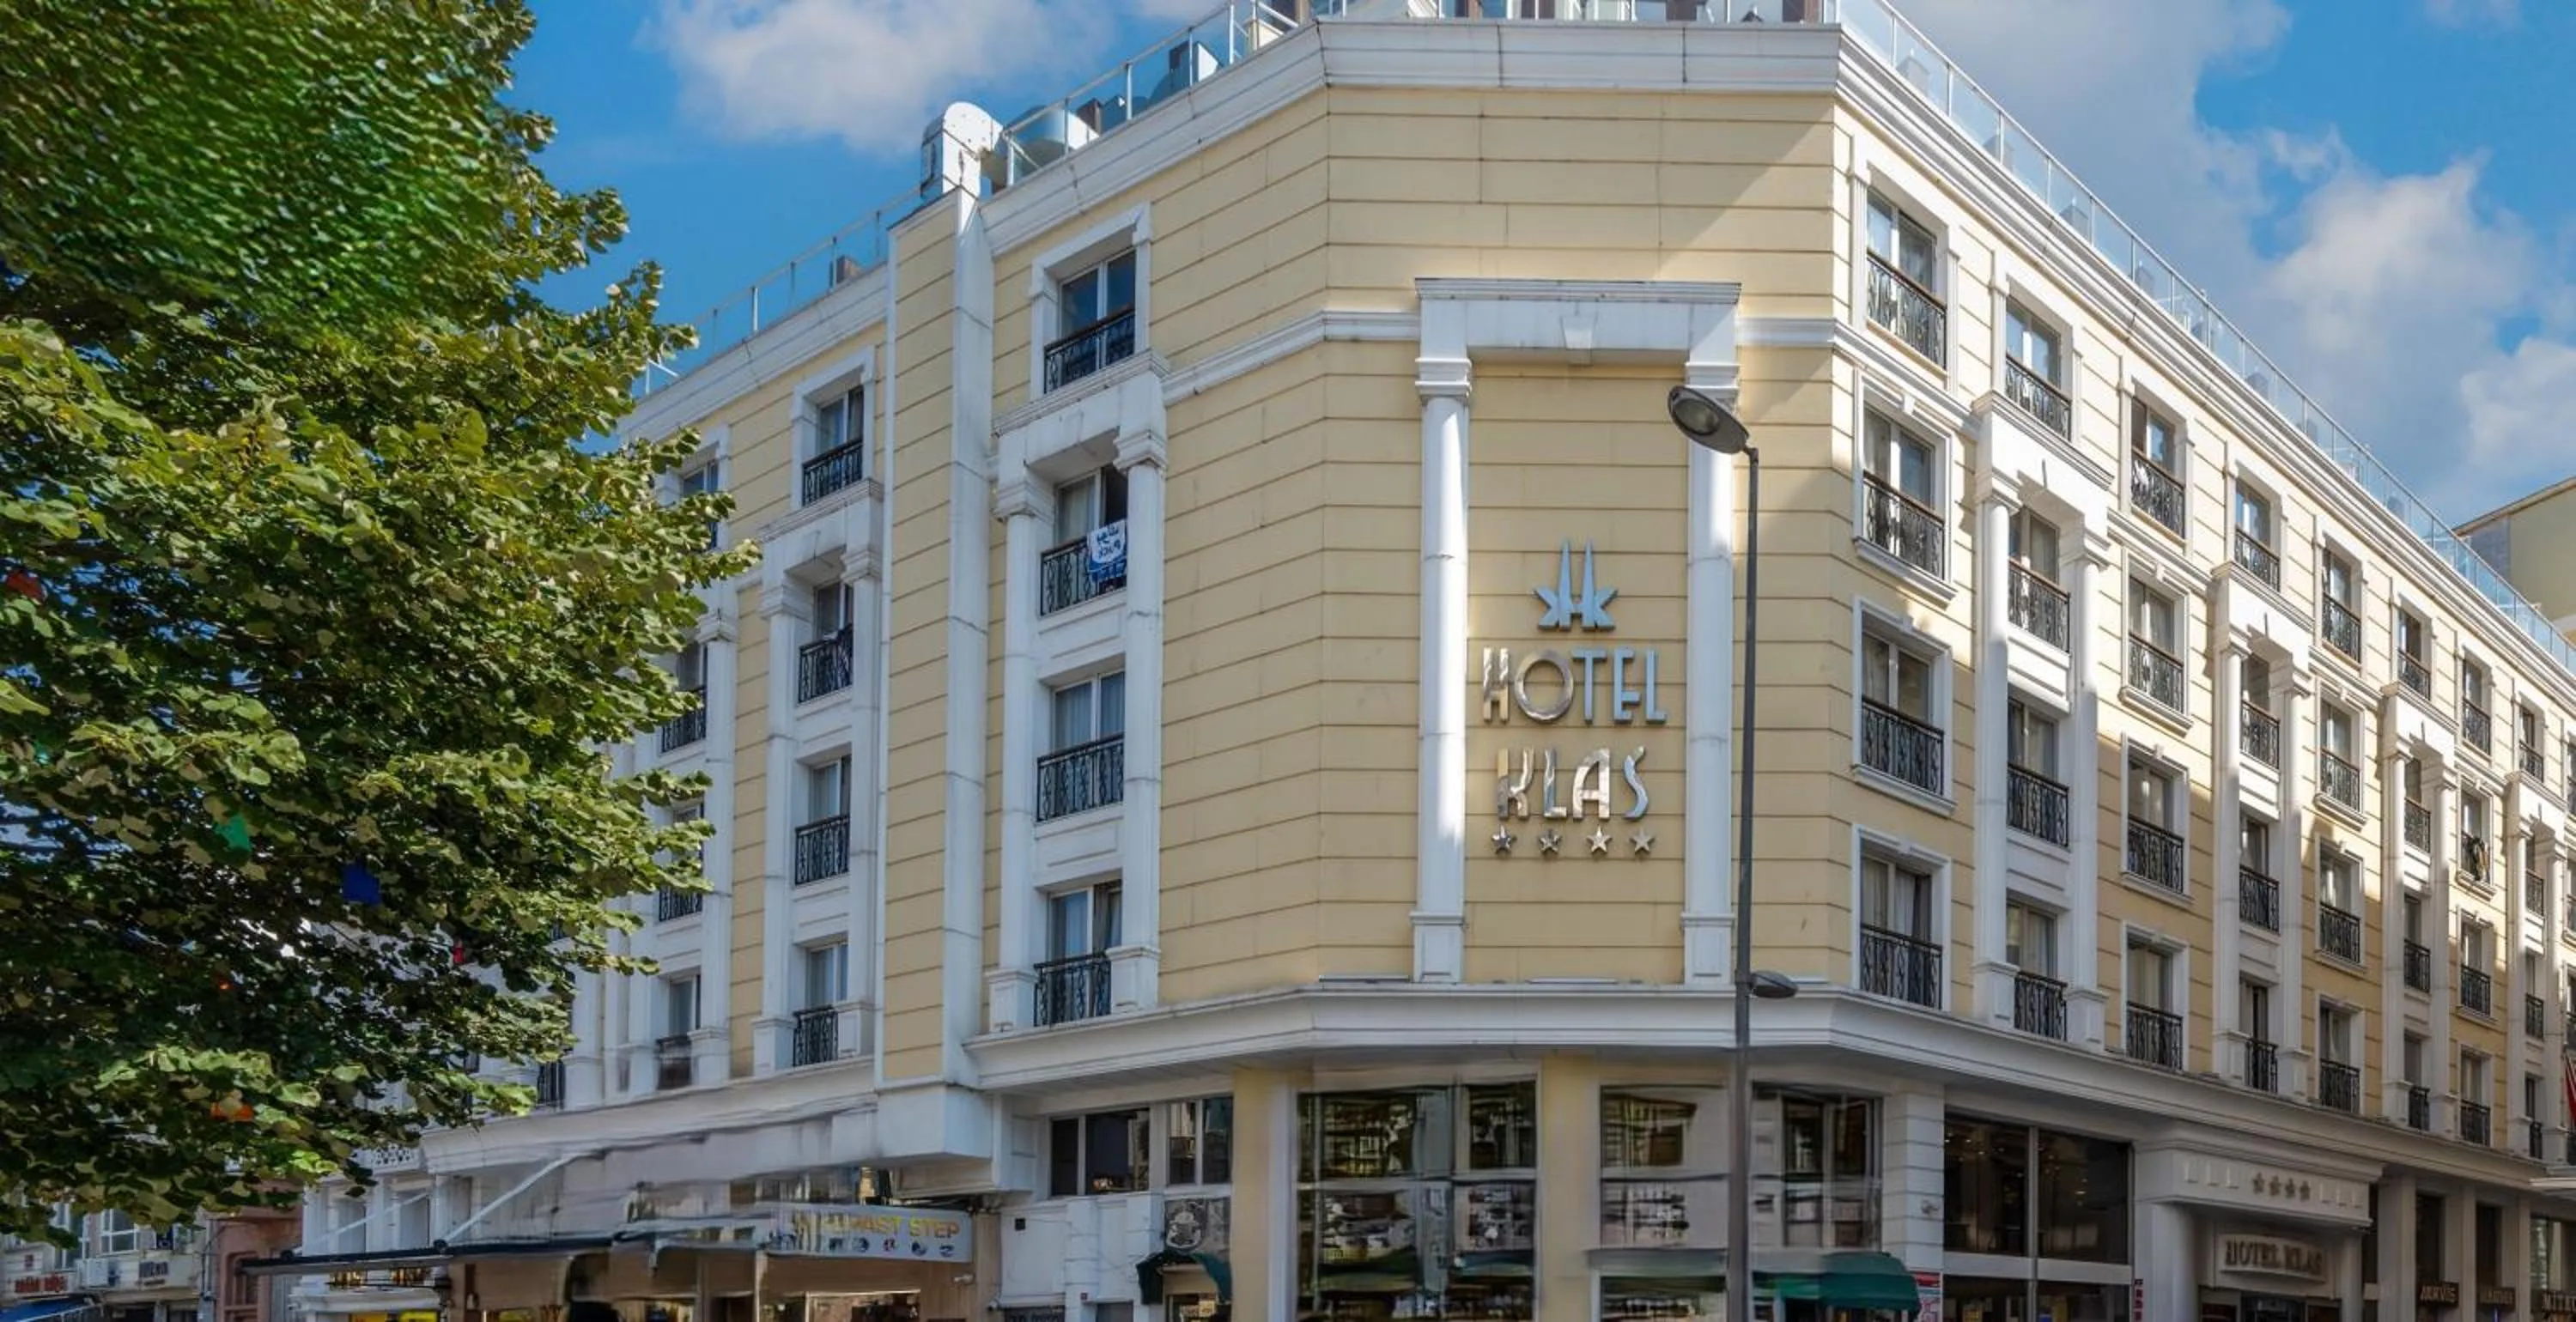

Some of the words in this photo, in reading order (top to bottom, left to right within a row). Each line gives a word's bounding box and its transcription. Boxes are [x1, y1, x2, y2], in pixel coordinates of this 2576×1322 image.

[1483, 646, 1668, 725] HOTEL
[1497, 745, 1650, 821] KLAS
[909, 1217, 961, 1238] STEP
